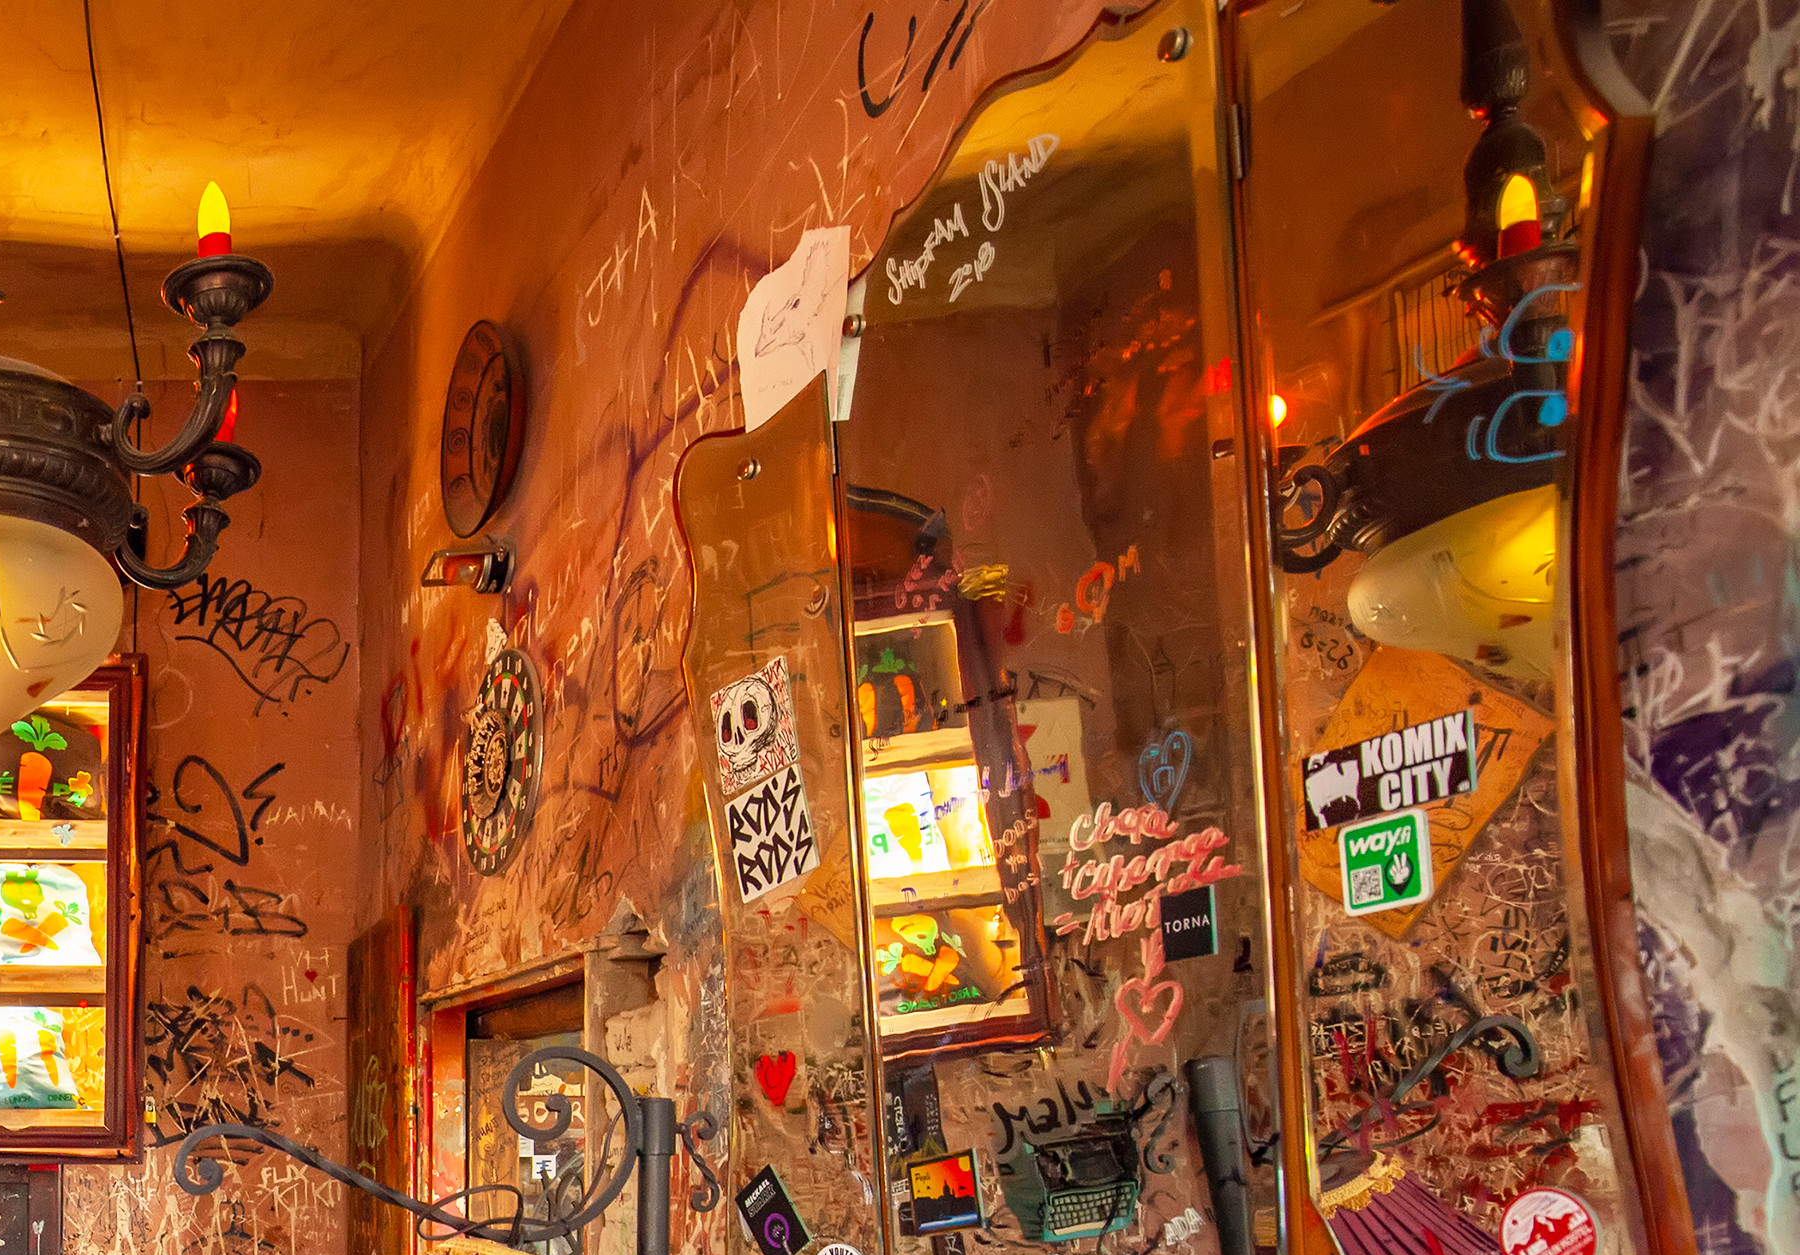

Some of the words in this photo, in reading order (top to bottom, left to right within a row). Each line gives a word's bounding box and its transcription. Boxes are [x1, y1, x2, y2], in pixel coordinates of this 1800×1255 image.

[1362, 712, 1467, 778] KOMIX
[1379, 757, 1453, 812] CITY
[1349, 824, 1412, 857] way.fi
[1163, 913, 1211, 934] TORNA
[744, 1178, 771, 1209] MICKAEL
[747, 1183, 777, 1219] STARK
